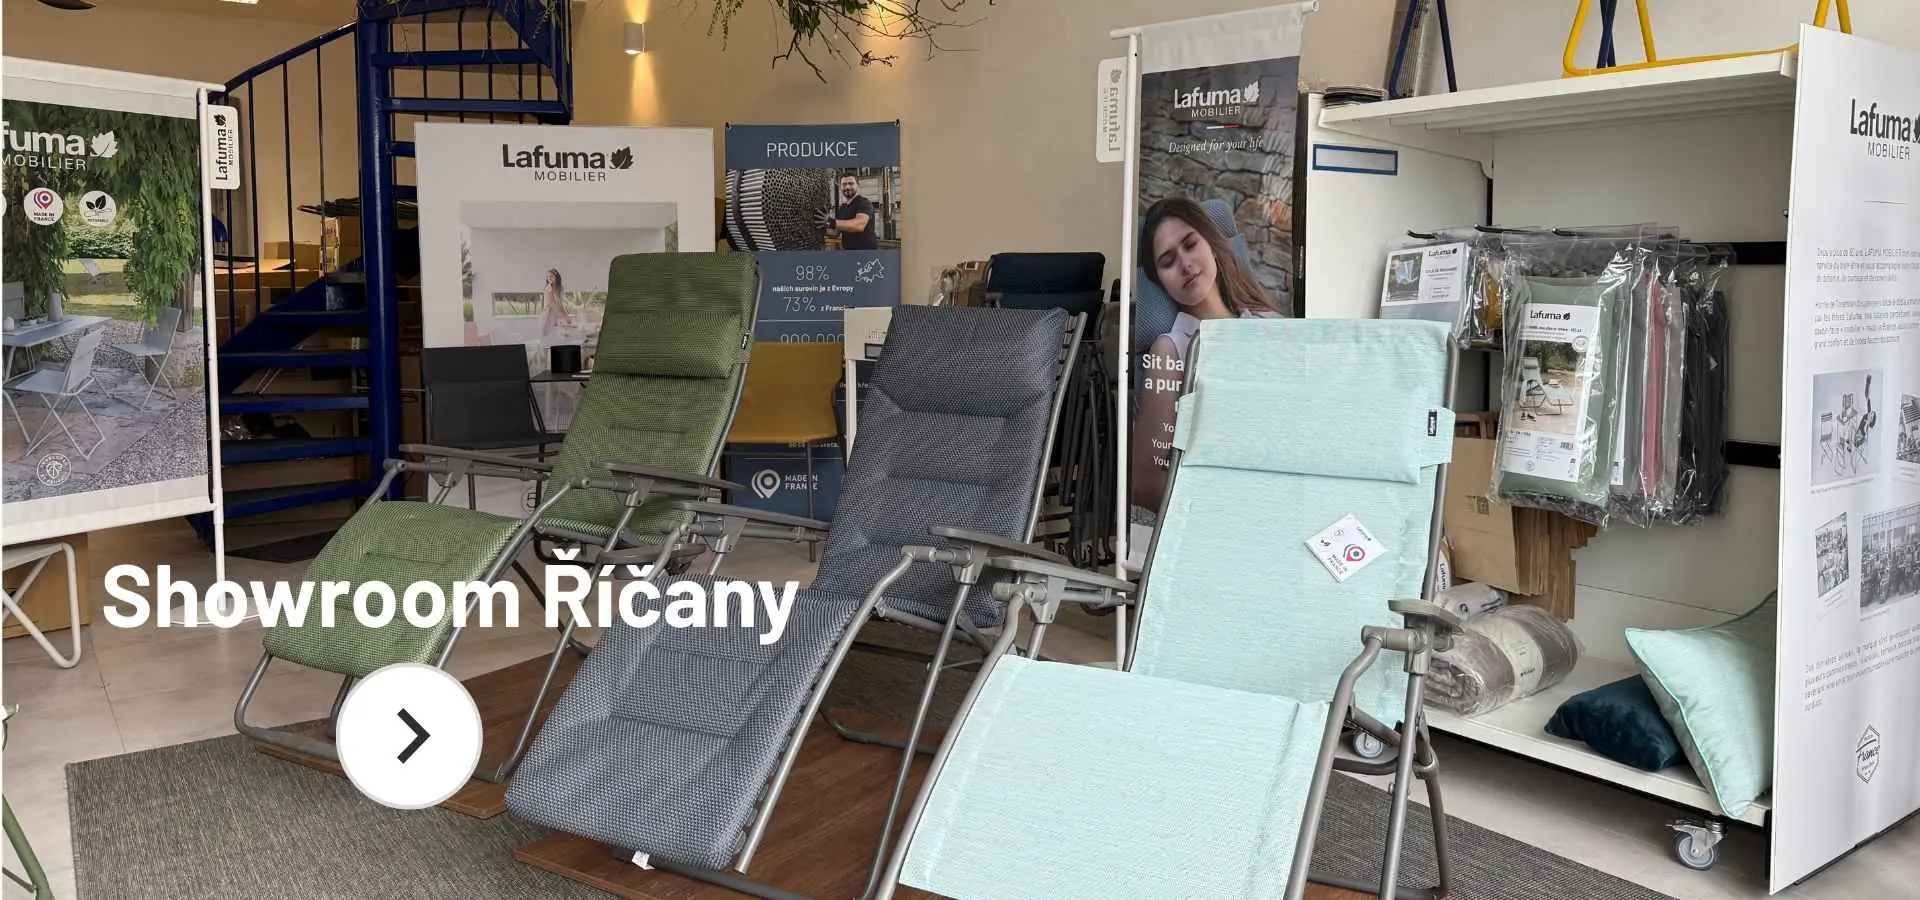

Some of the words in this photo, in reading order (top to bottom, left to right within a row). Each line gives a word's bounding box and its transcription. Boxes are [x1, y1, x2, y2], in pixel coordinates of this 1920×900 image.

[1174, 87, 1241, 109] Lafuma
[1191, 105, 1241, 118] MOBILIER
[1850, 98, 1911, 142] Lafuma
[766, 141, 859, 158] PRODUKCE
[1168, 139, 1207, 154] Designed
[1207, 138, 1225, 153] for
[1225, 139, 1246, 152] your
[1249, 136, 1263, 151] life
[1867, 141, 1911, 160] MOBILIER
[215, 128, 228, 181] Lafuma
[502, 144, 606, 169] Lafuma
[534, 171, 606, 182] MOBILIER
[795, 265, 830, 281] 98%
[832, 285, 854, 294] Evropy
[783, 296, 816, 312] 73%
[1530, 310, 1562, 320] Lafuma
[1142, 353, 1162, 370] Sit
[1144, 378, 1153, 390] a
[1152, 438, 1173, 449] Your
[785, 474, 808, 482] MADE
[785, 482, 818, 490] FRANE
